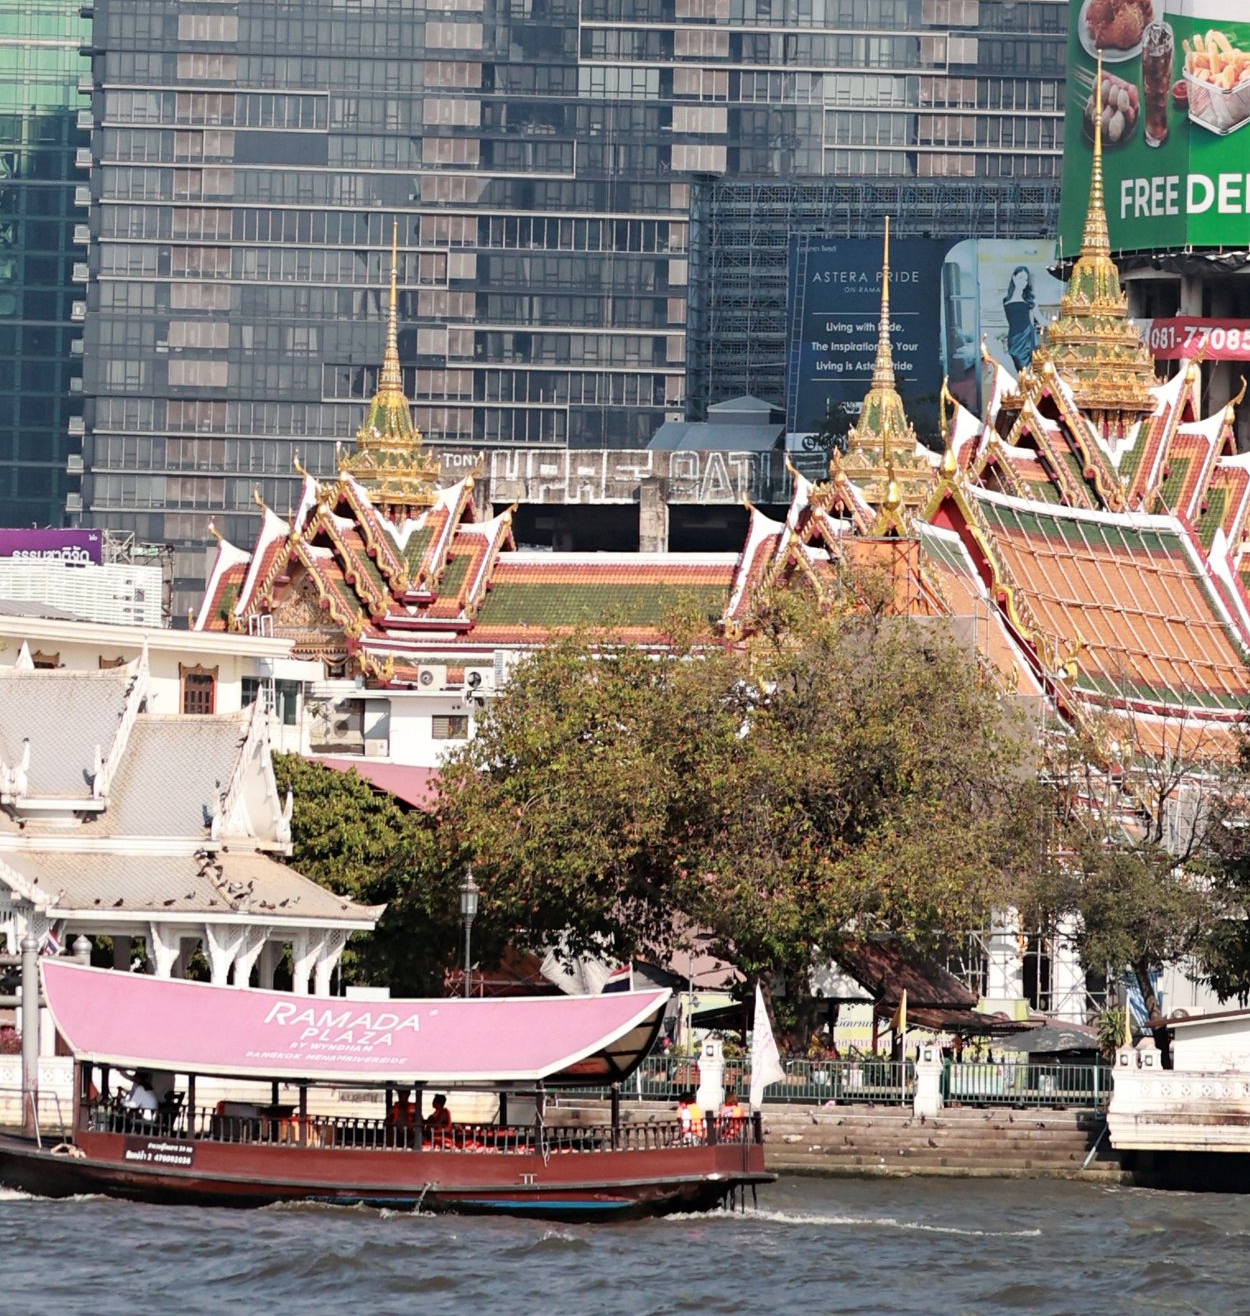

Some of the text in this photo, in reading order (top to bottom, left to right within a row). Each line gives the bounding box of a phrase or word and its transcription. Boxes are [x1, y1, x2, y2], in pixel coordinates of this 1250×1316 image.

[1119, 175, 1179, 219] FREE
[812, 271, 919, 283] ASTERA PRIDE
[826, 322, 853, 334] Living
[856, 322, 875, 332] with
[811, 341, 829, 351] The
[831, 341, 879, 353] Inspiration
[896, 341, 919, 351] Your
[816, 361, 843, 372] Living
[845, 362, 853, 371] is
[443, 452, 481, 468] TONY
[264, 1001, 421, 1032] RAMADA
[300, 1027, 393, 1046] PLAZA
[310, 1042, 374, 1053] WYNDHAM
[245, 1051, 302, 1061] BANGKOK
